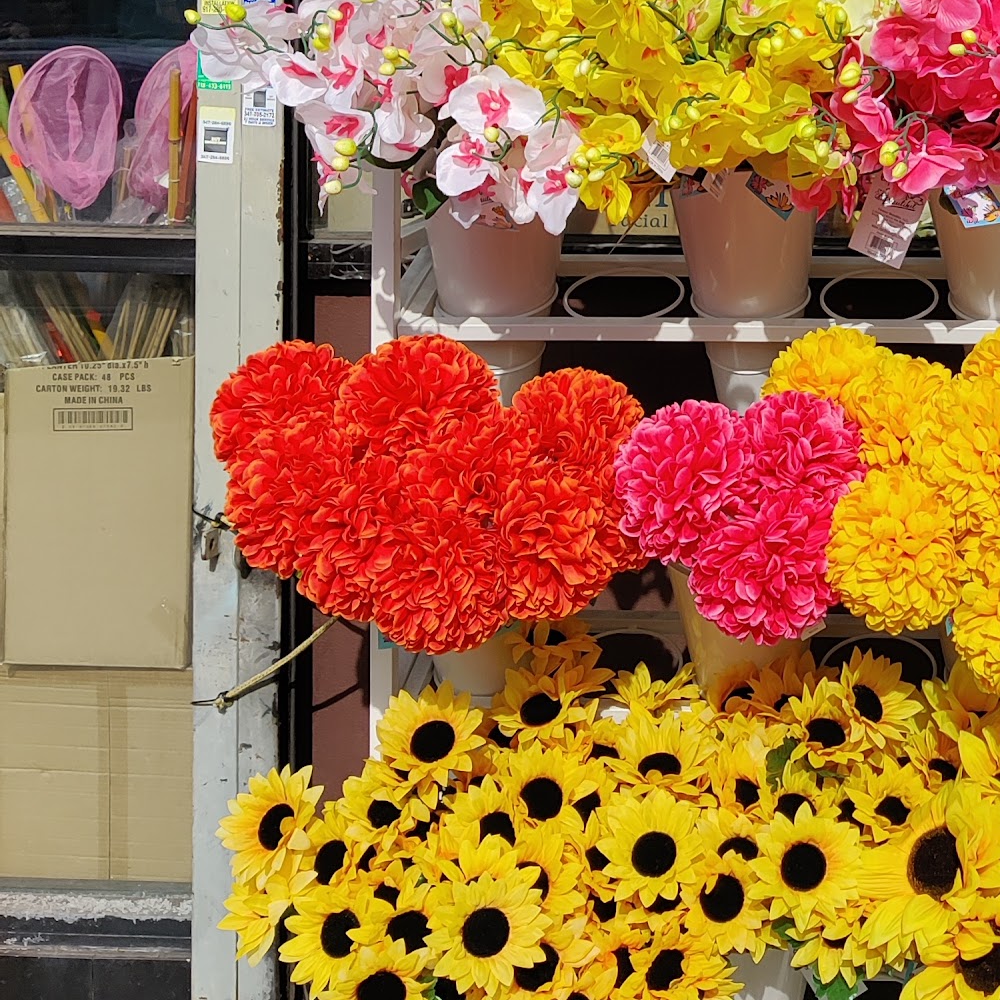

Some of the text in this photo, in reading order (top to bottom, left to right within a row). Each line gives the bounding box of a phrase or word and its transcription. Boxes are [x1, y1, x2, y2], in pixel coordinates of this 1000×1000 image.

[621, 213, 669, 228] cial
[52, 373, 73, 381] CASE
[101, 373, 111, 381] 48
